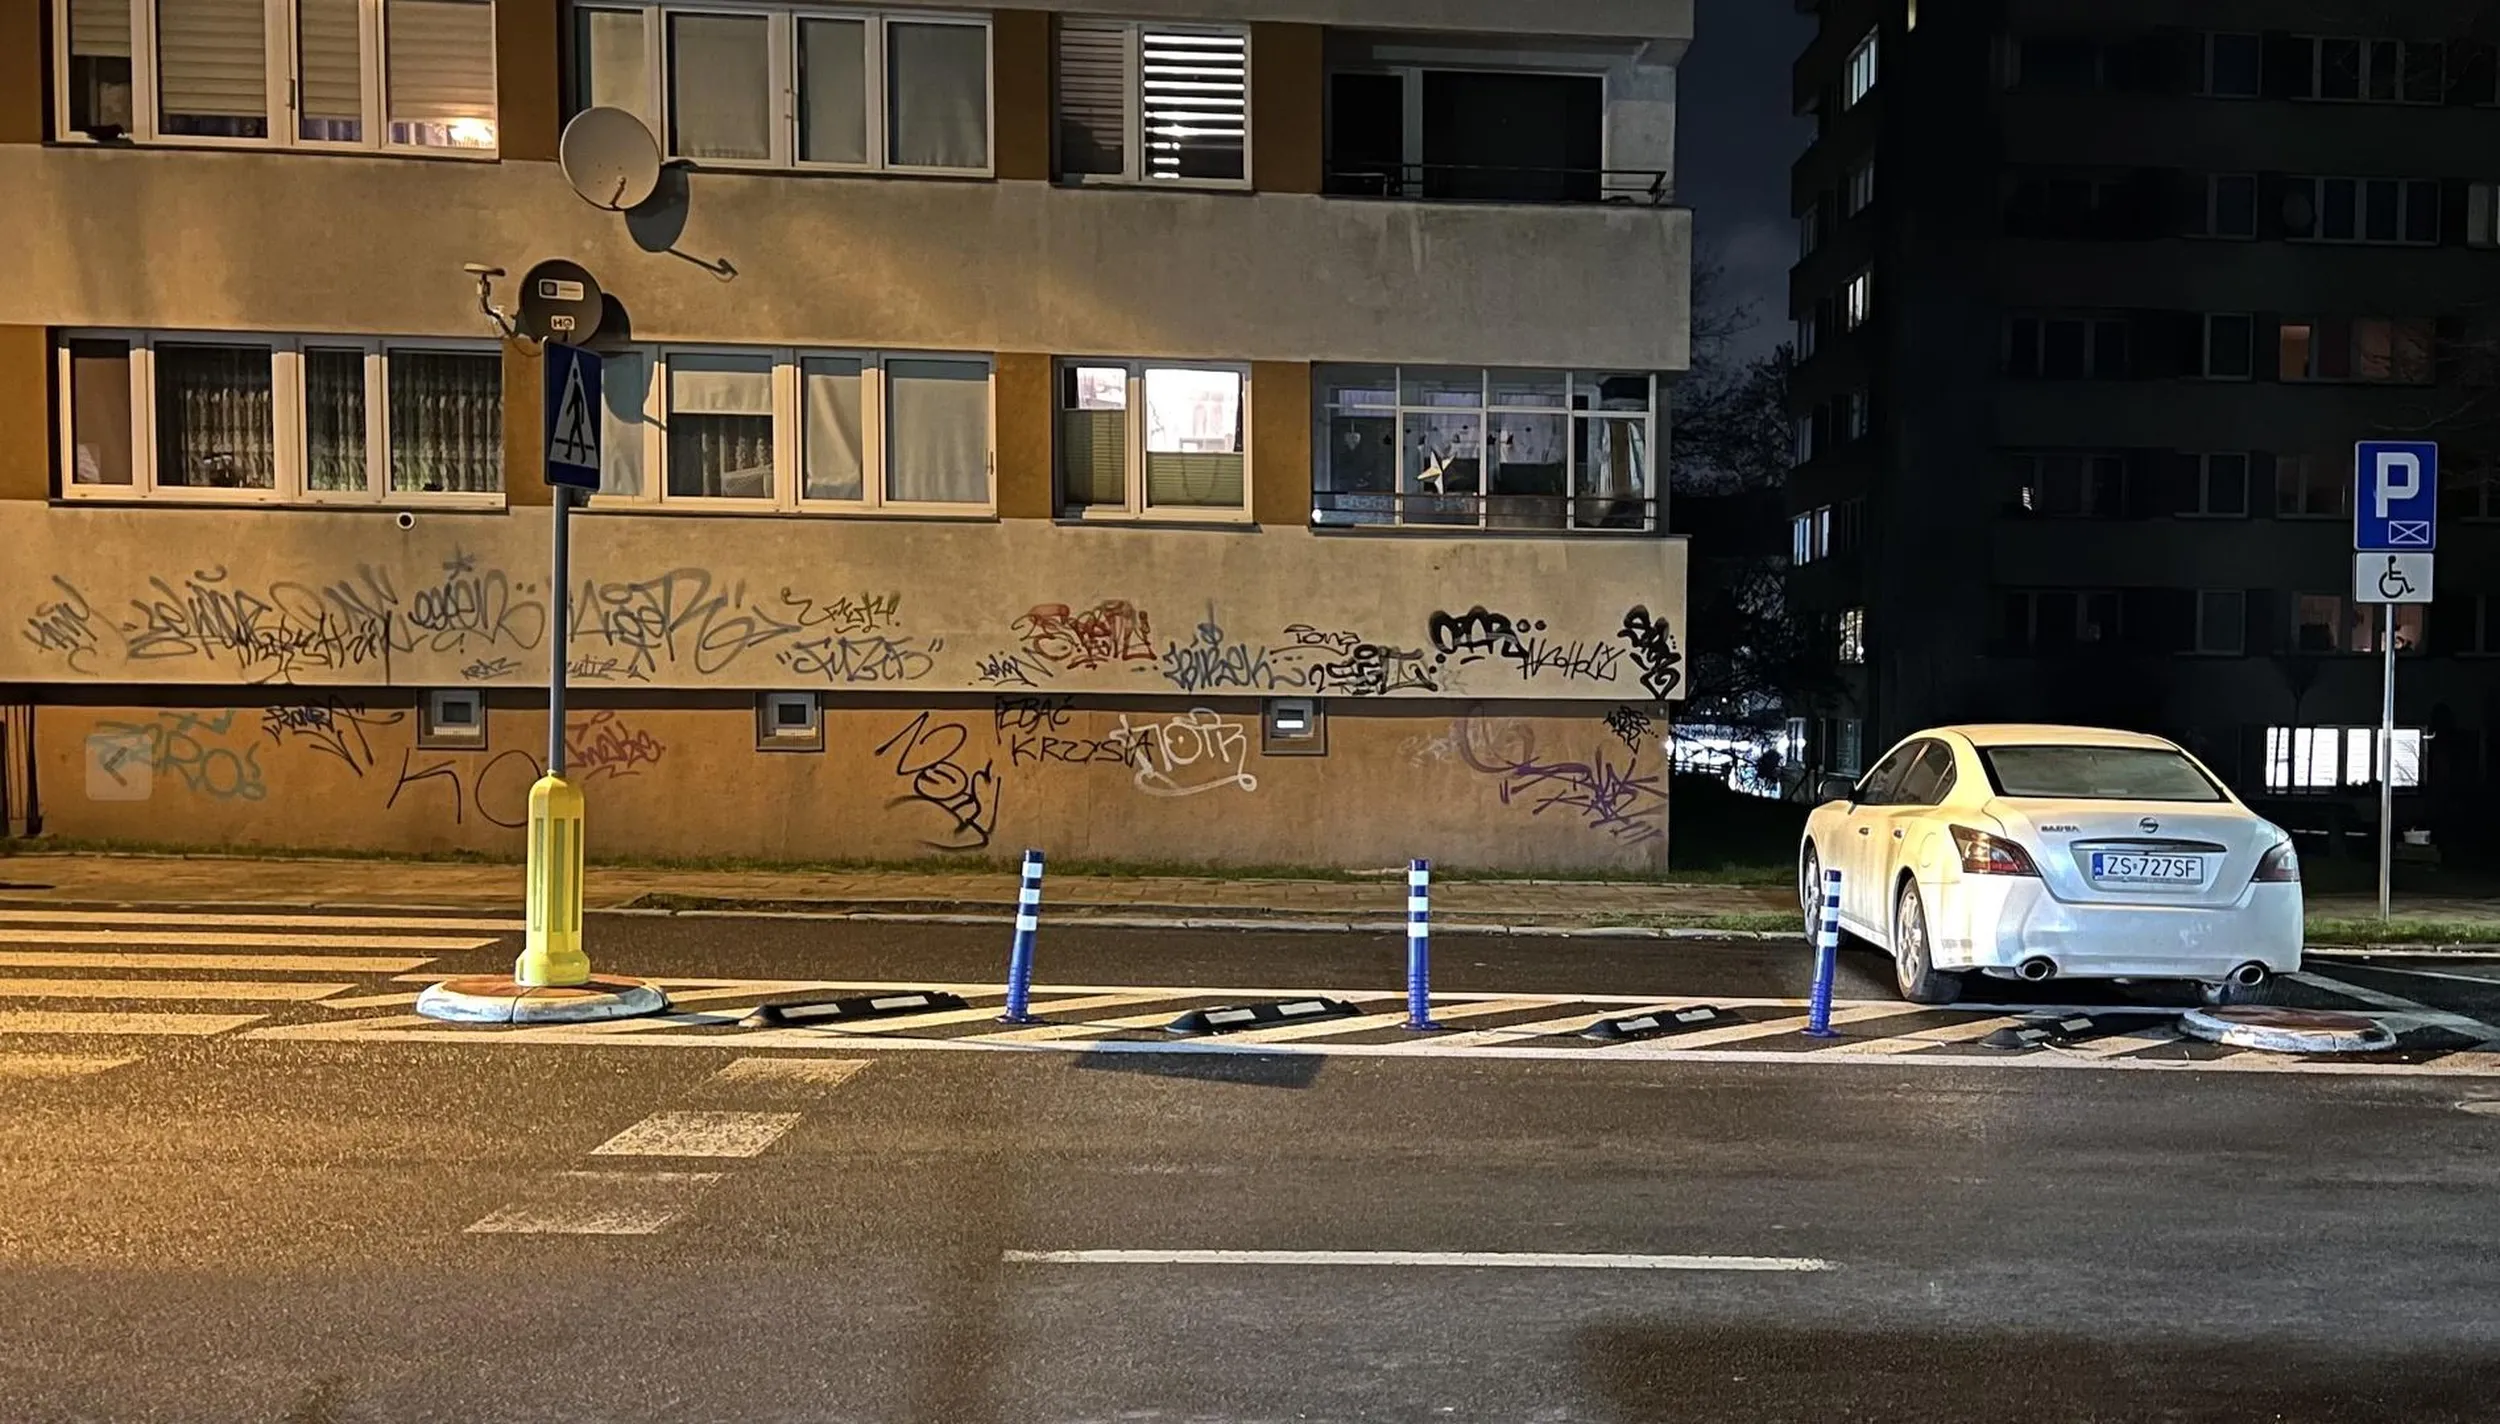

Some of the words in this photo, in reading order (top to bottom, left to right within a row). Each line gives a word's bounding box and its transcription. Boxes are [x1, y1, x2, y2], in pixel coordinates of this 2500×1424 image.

[2376, 452, 2420, 518] P
[2107, 856, 2132, 875] ZS
[2139, 858, 2196, 878] 727SF
